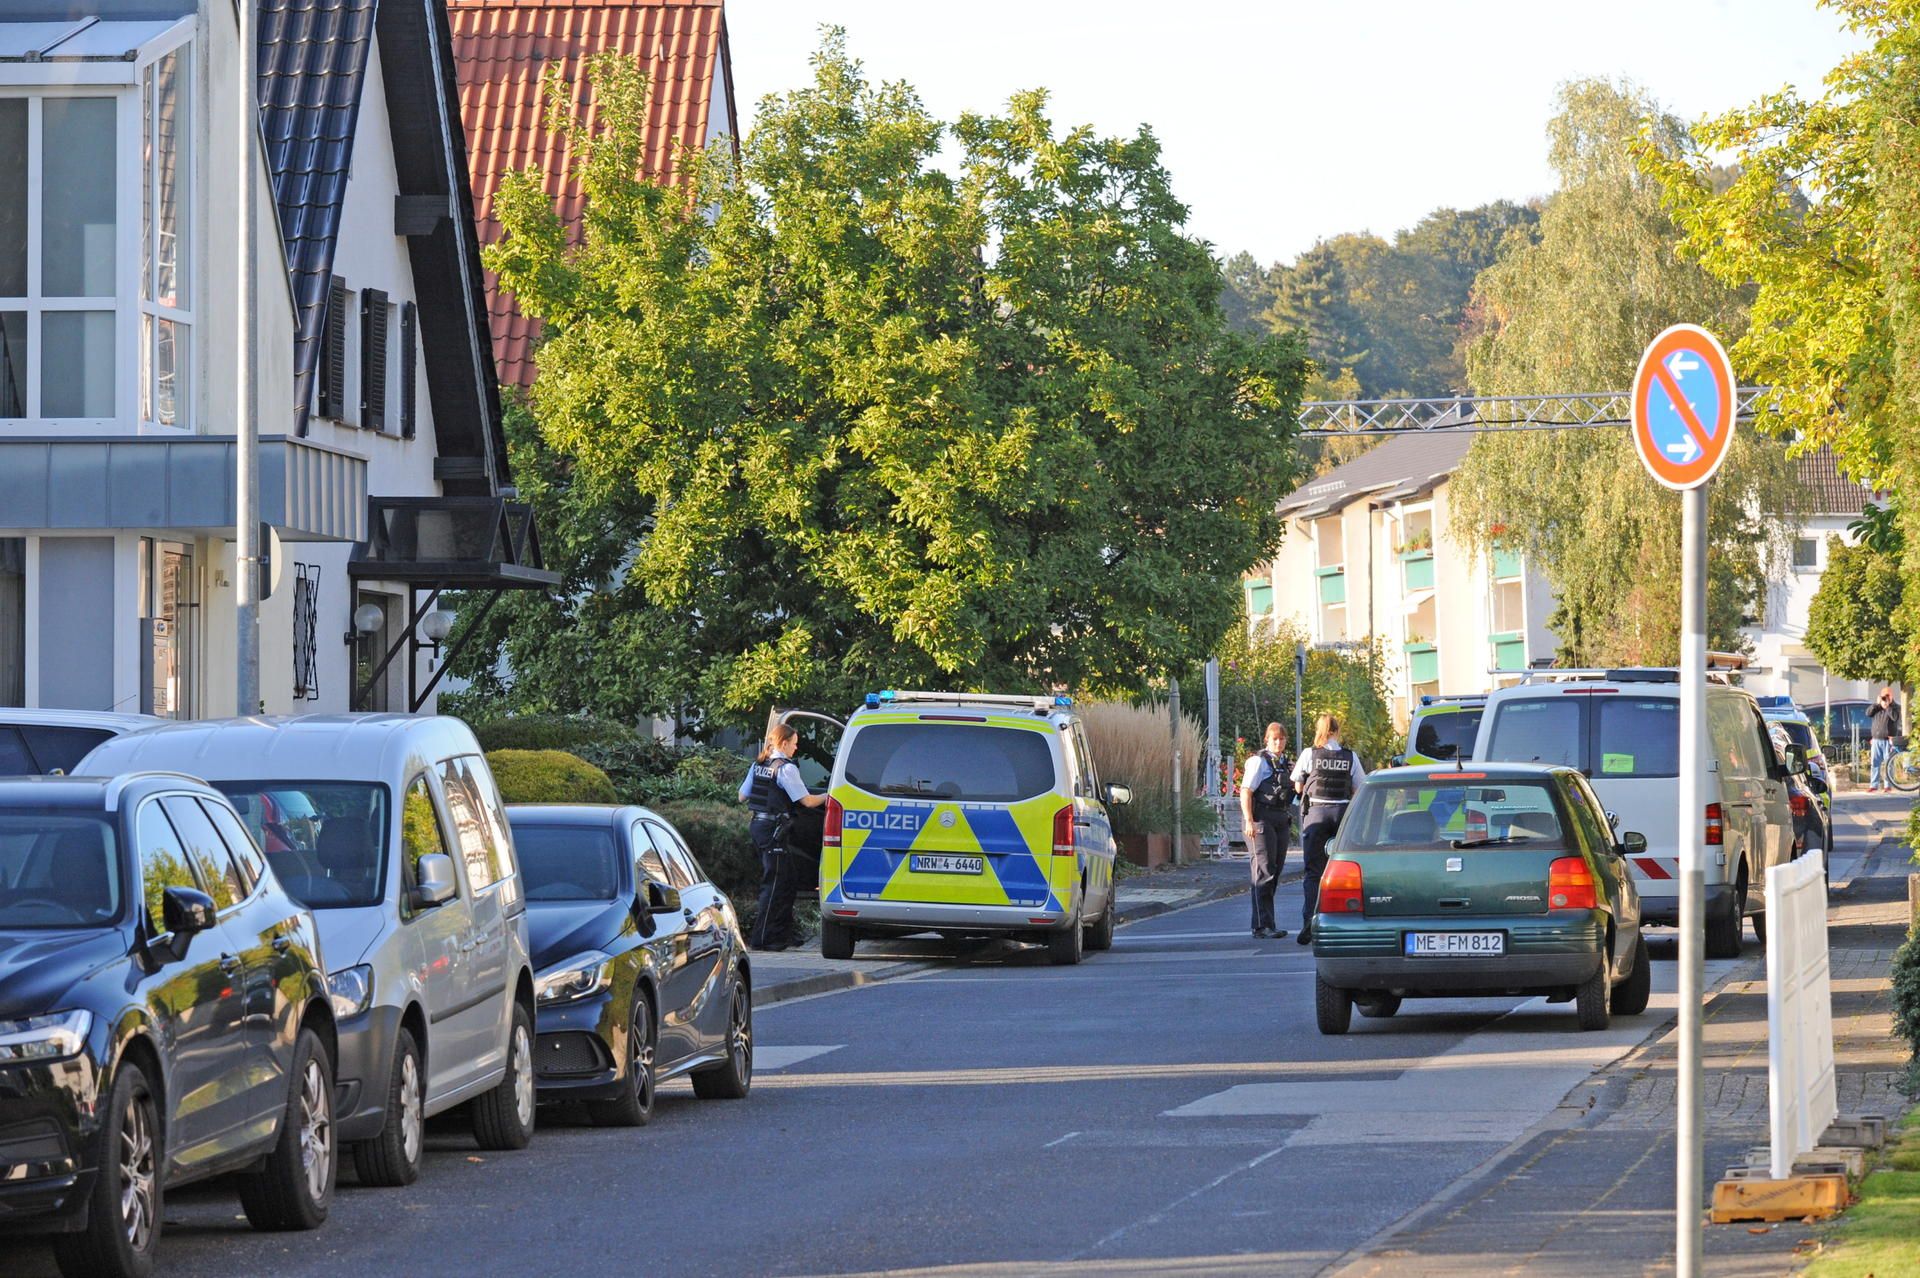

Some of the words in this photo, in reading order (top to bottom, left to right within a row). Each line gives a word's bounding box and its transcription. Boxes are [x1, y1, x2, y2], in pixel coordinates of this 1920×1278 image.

[1315, 758, 1350, 770] POLIZEI
[844, 811, 920, 830] POLIZEI
[916, 856, 937, 869] NRW
[1416, 936, 1436, 950] ME
[1447, 936, 1468, 950] FM
[1472, 936, 1501, 950] 812
